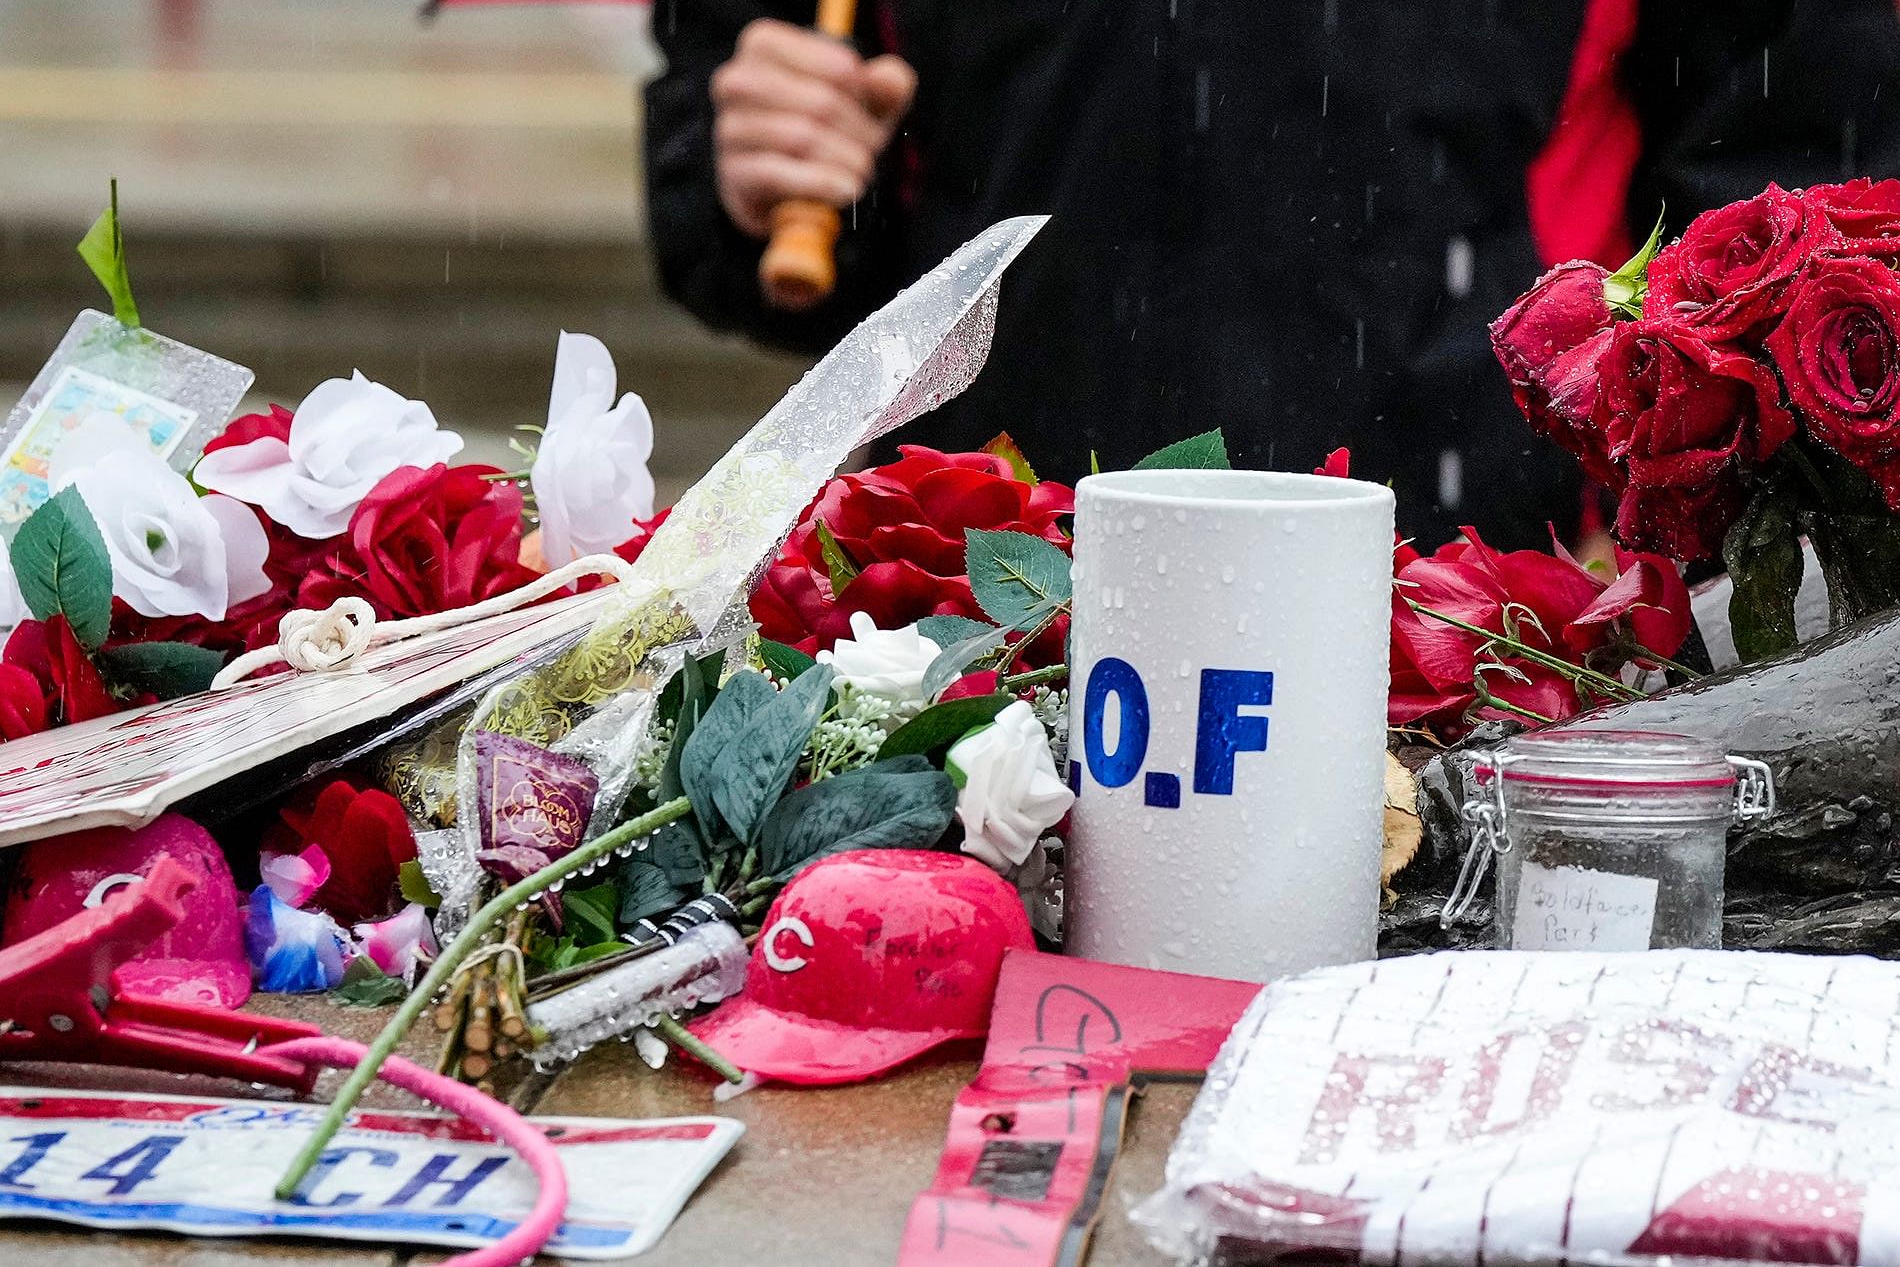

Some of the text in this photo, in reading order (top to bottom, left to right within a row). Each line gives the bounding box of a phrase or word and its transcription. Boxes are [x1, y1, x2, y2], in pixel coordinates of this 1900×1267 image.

[522, 793, 571, 821] BLOOM
[522, 809, 572, 835] HAUS
[763, 916, 815, 973] C
[1296, 1017, 1876, 1165] ROSE
[289, 1145, 510, 1208] CH
